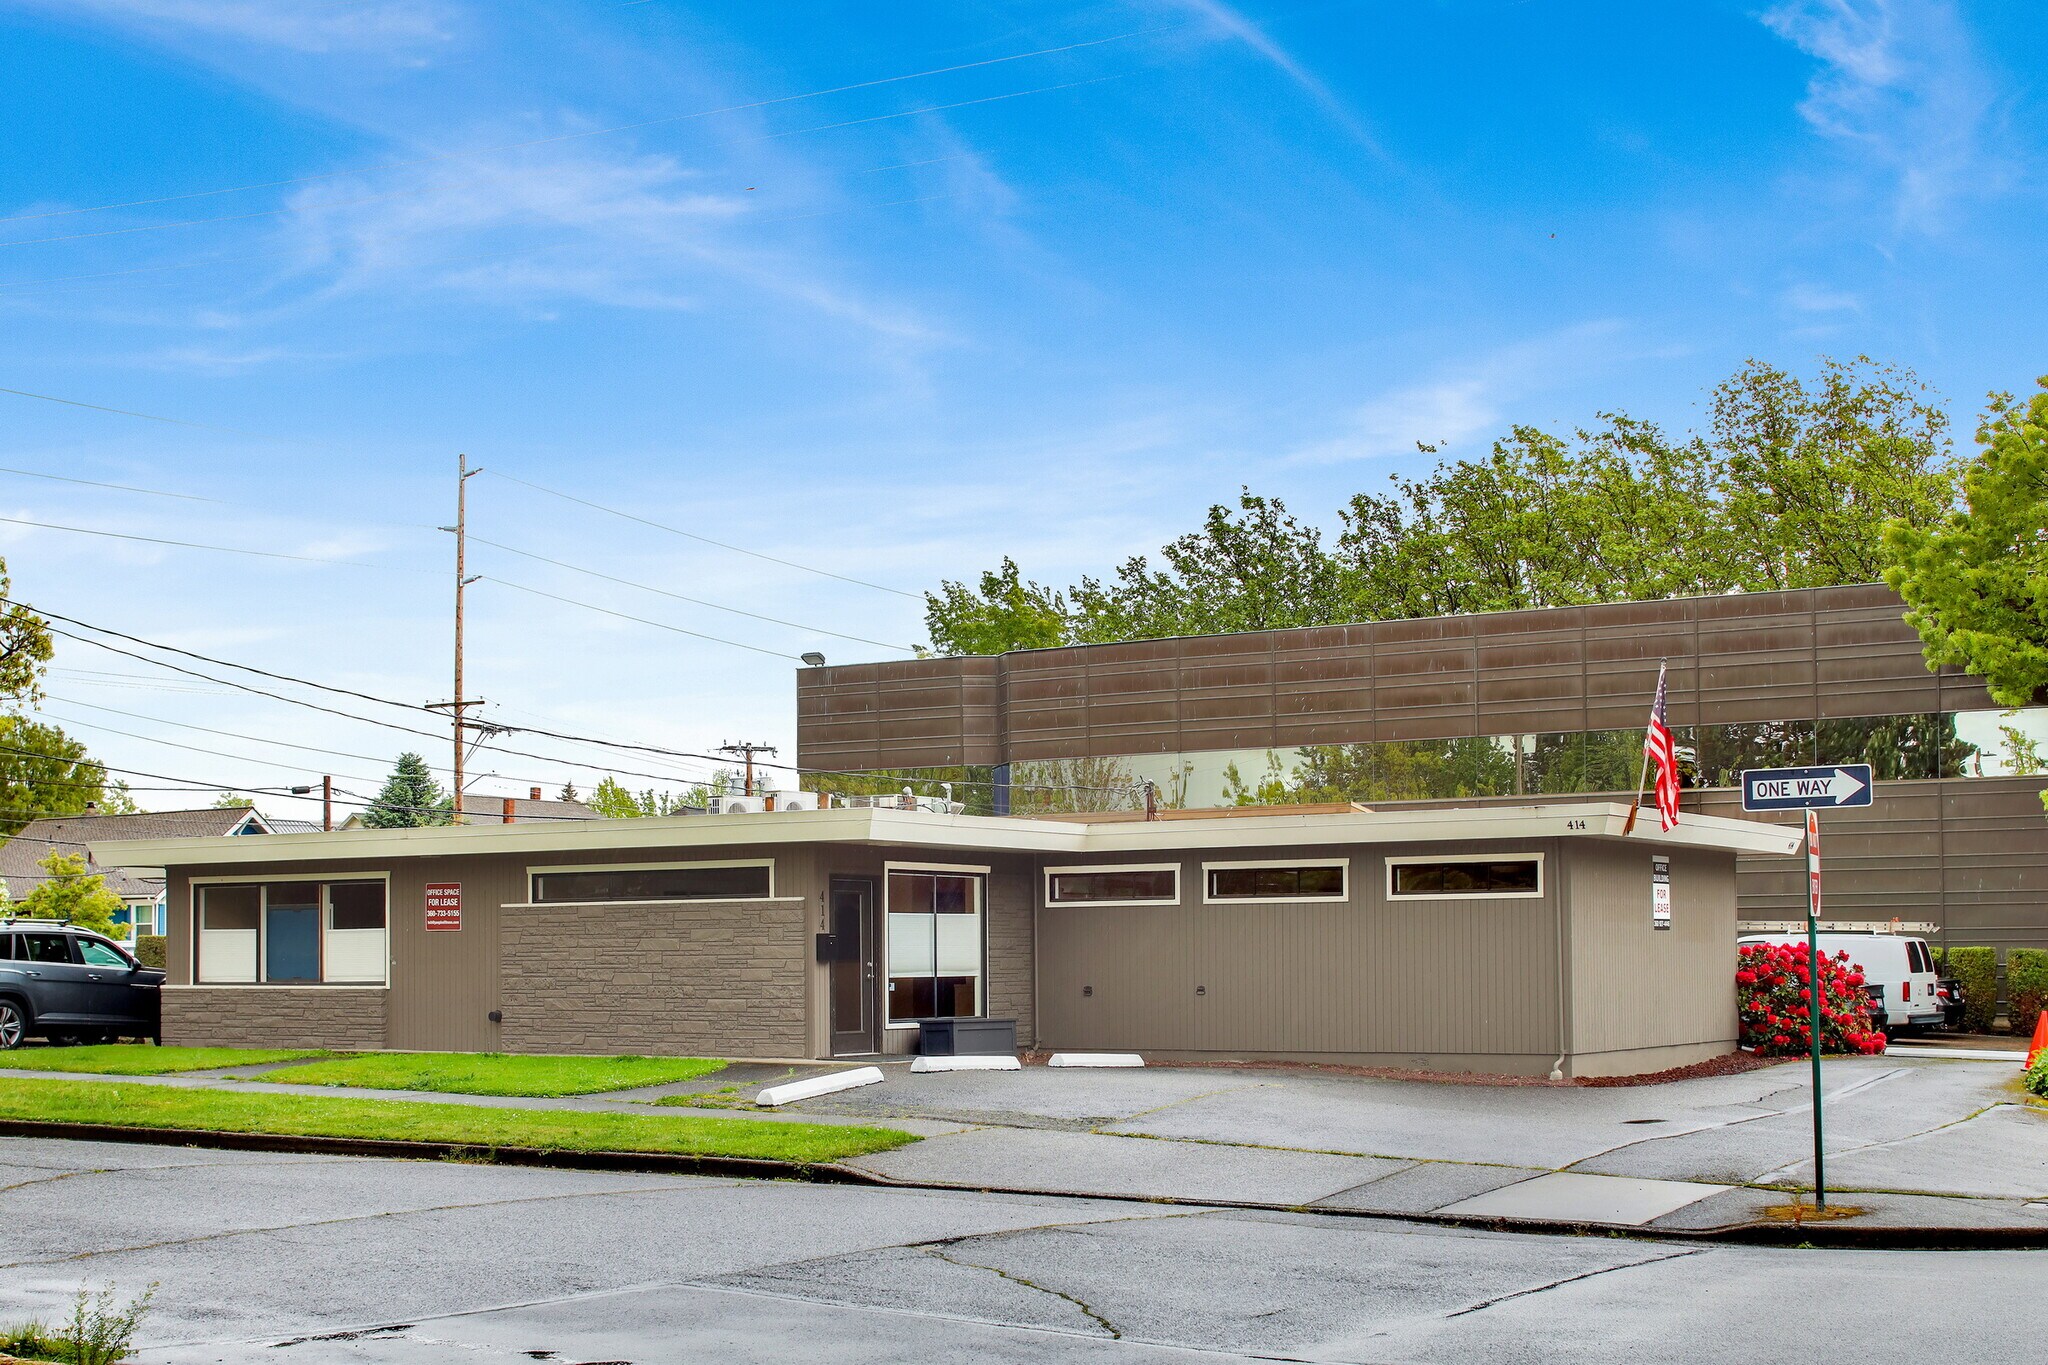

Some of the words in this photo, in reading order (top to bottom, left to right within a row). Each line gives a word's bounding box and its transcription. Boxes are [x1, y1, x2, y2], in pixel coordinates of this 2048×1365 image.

[1757, 781, 1790, 797] ONE
[1797, 779, 1832, 795] WAY
[1567, 820, 1586, 830] 414
[1655, 864, 1667, 872] OFFICE
[1657, 889, 1666, 898] FOR
[428, 898, 440, 906] FOR
[440, 898, 458, 906] LEASE
[1655, 903, 1669, 913] LEASE
